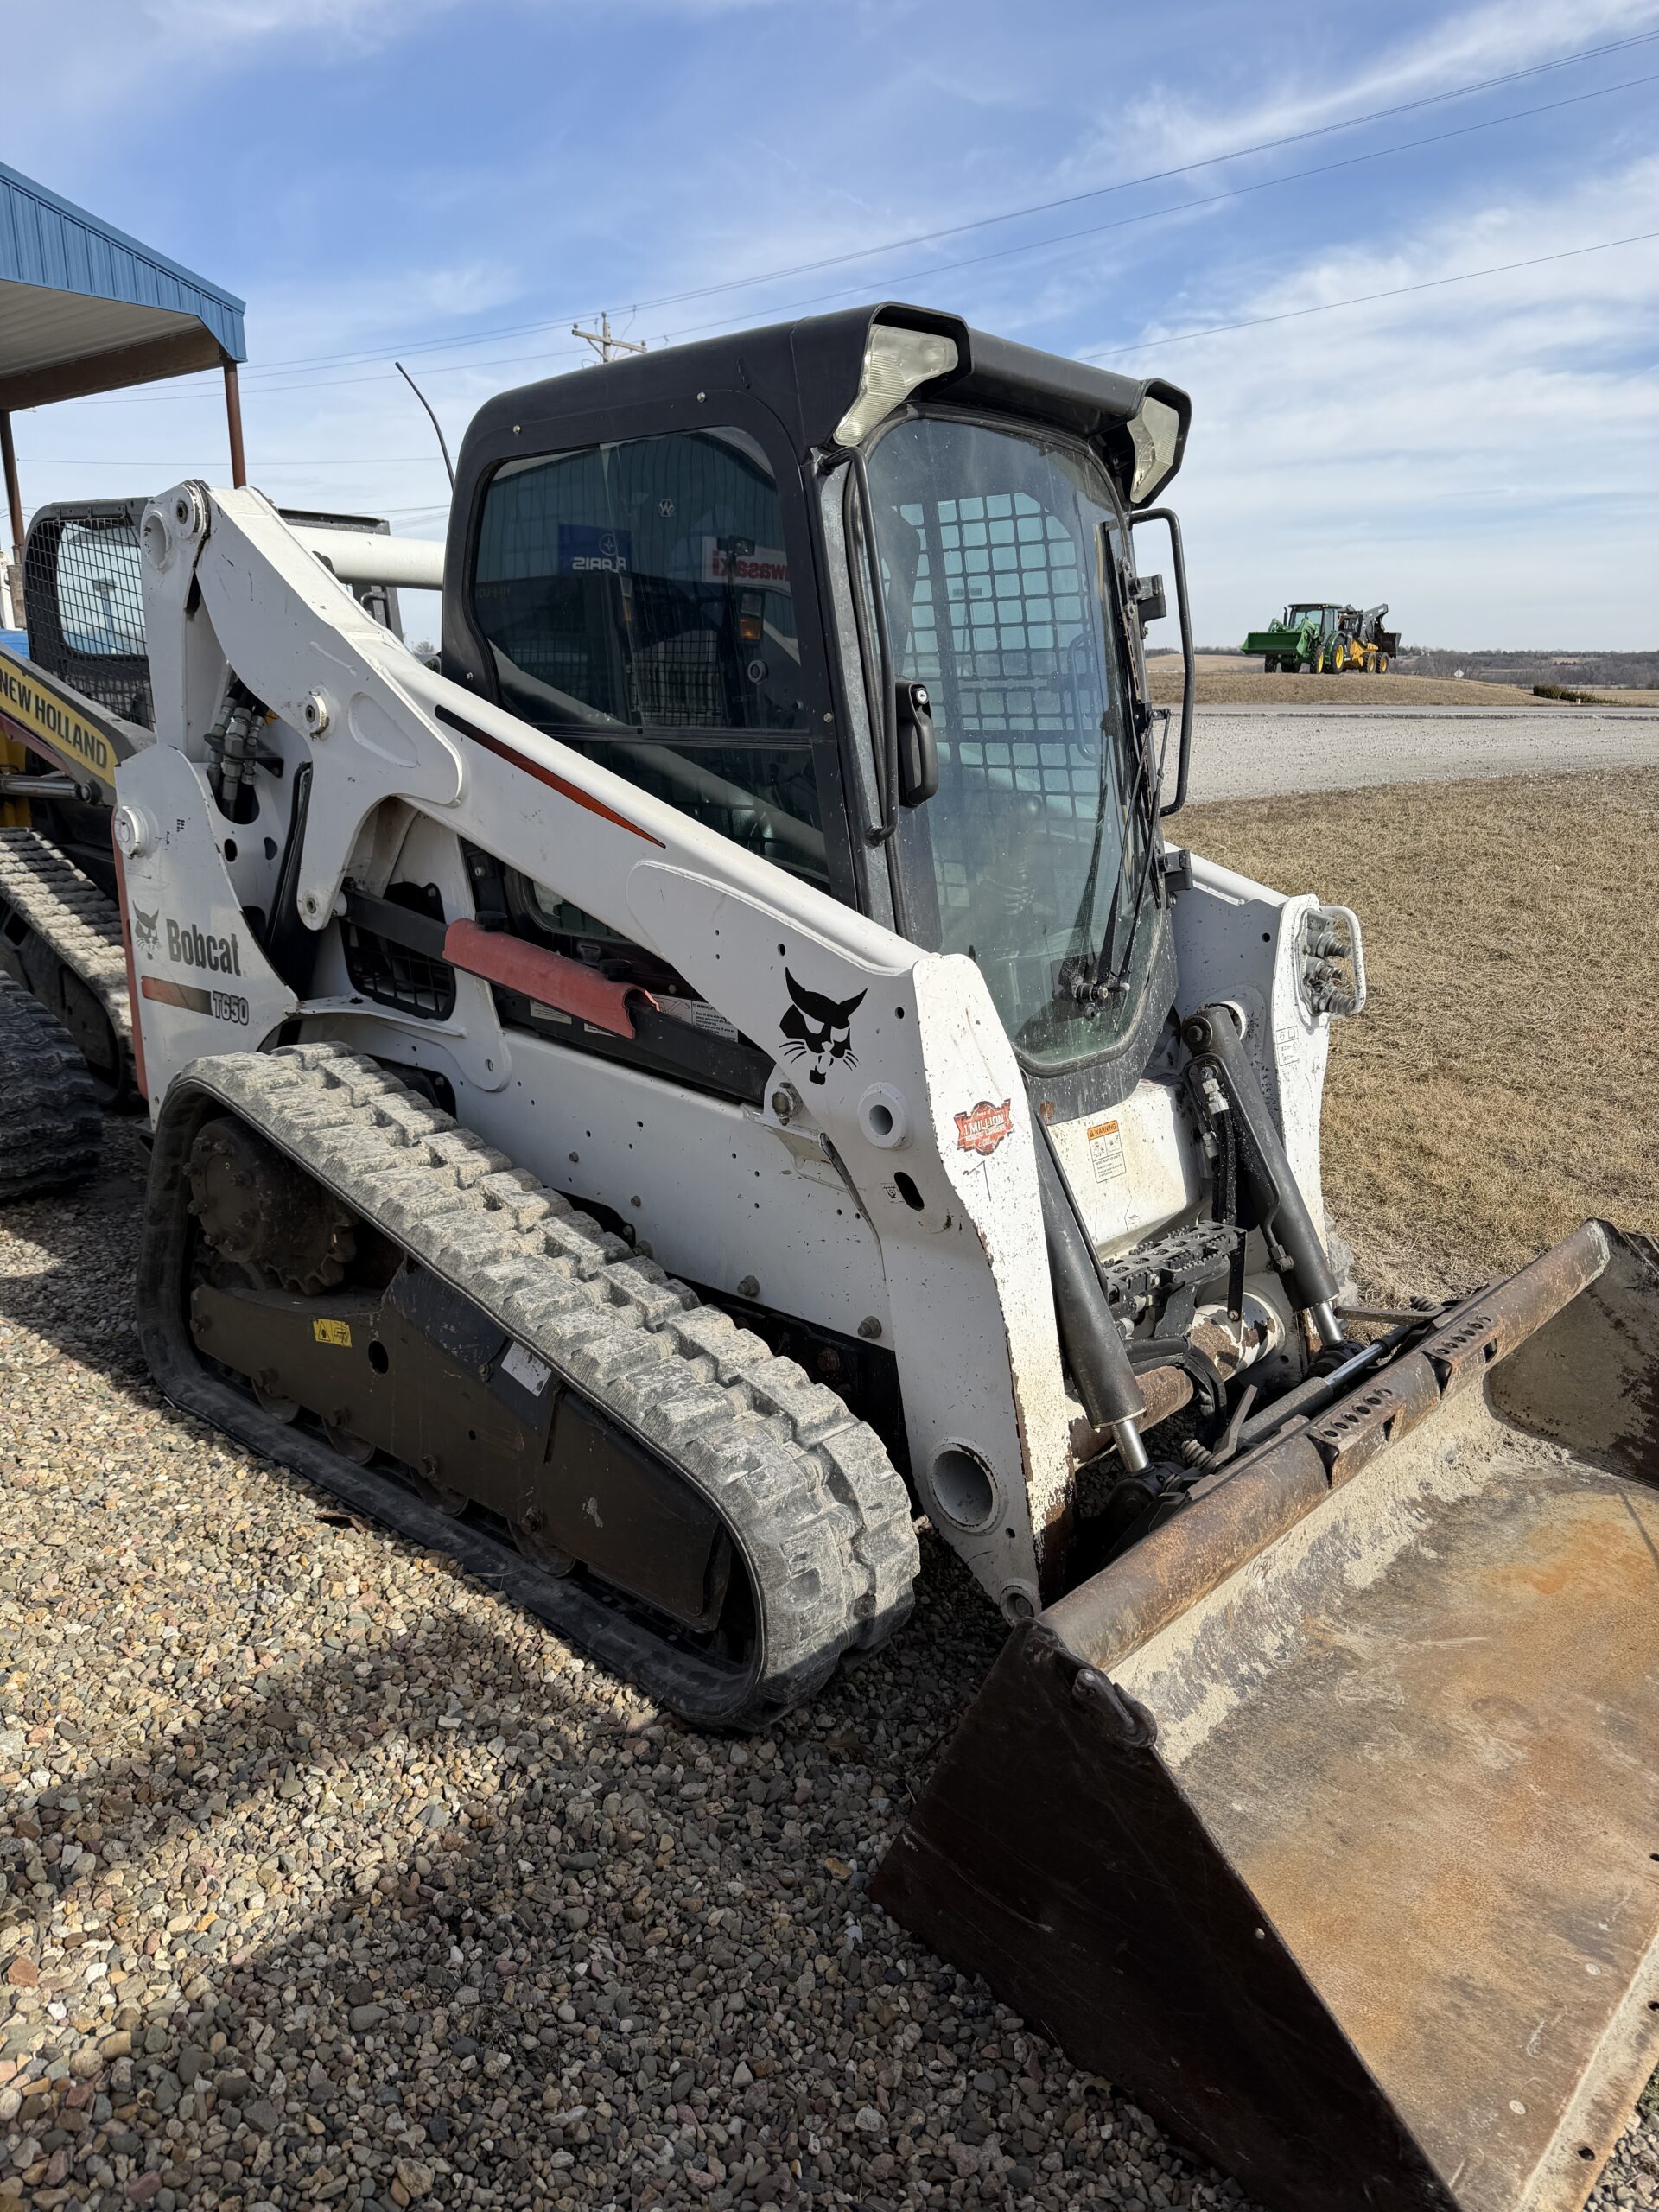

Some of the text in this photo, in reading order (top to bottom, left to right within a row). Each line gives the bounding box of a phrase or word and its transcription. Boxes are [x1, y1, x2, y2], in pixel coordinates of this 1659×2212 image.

[0, 668, 107, 769] NEW HOLLAND
[166, 918, 241, 977] Bobcat
[213, 990, 249, 1026] T650
[969, 1114, 1004, 1133] MILLION
[1095, 1124, 1116, 1135] WARNING
